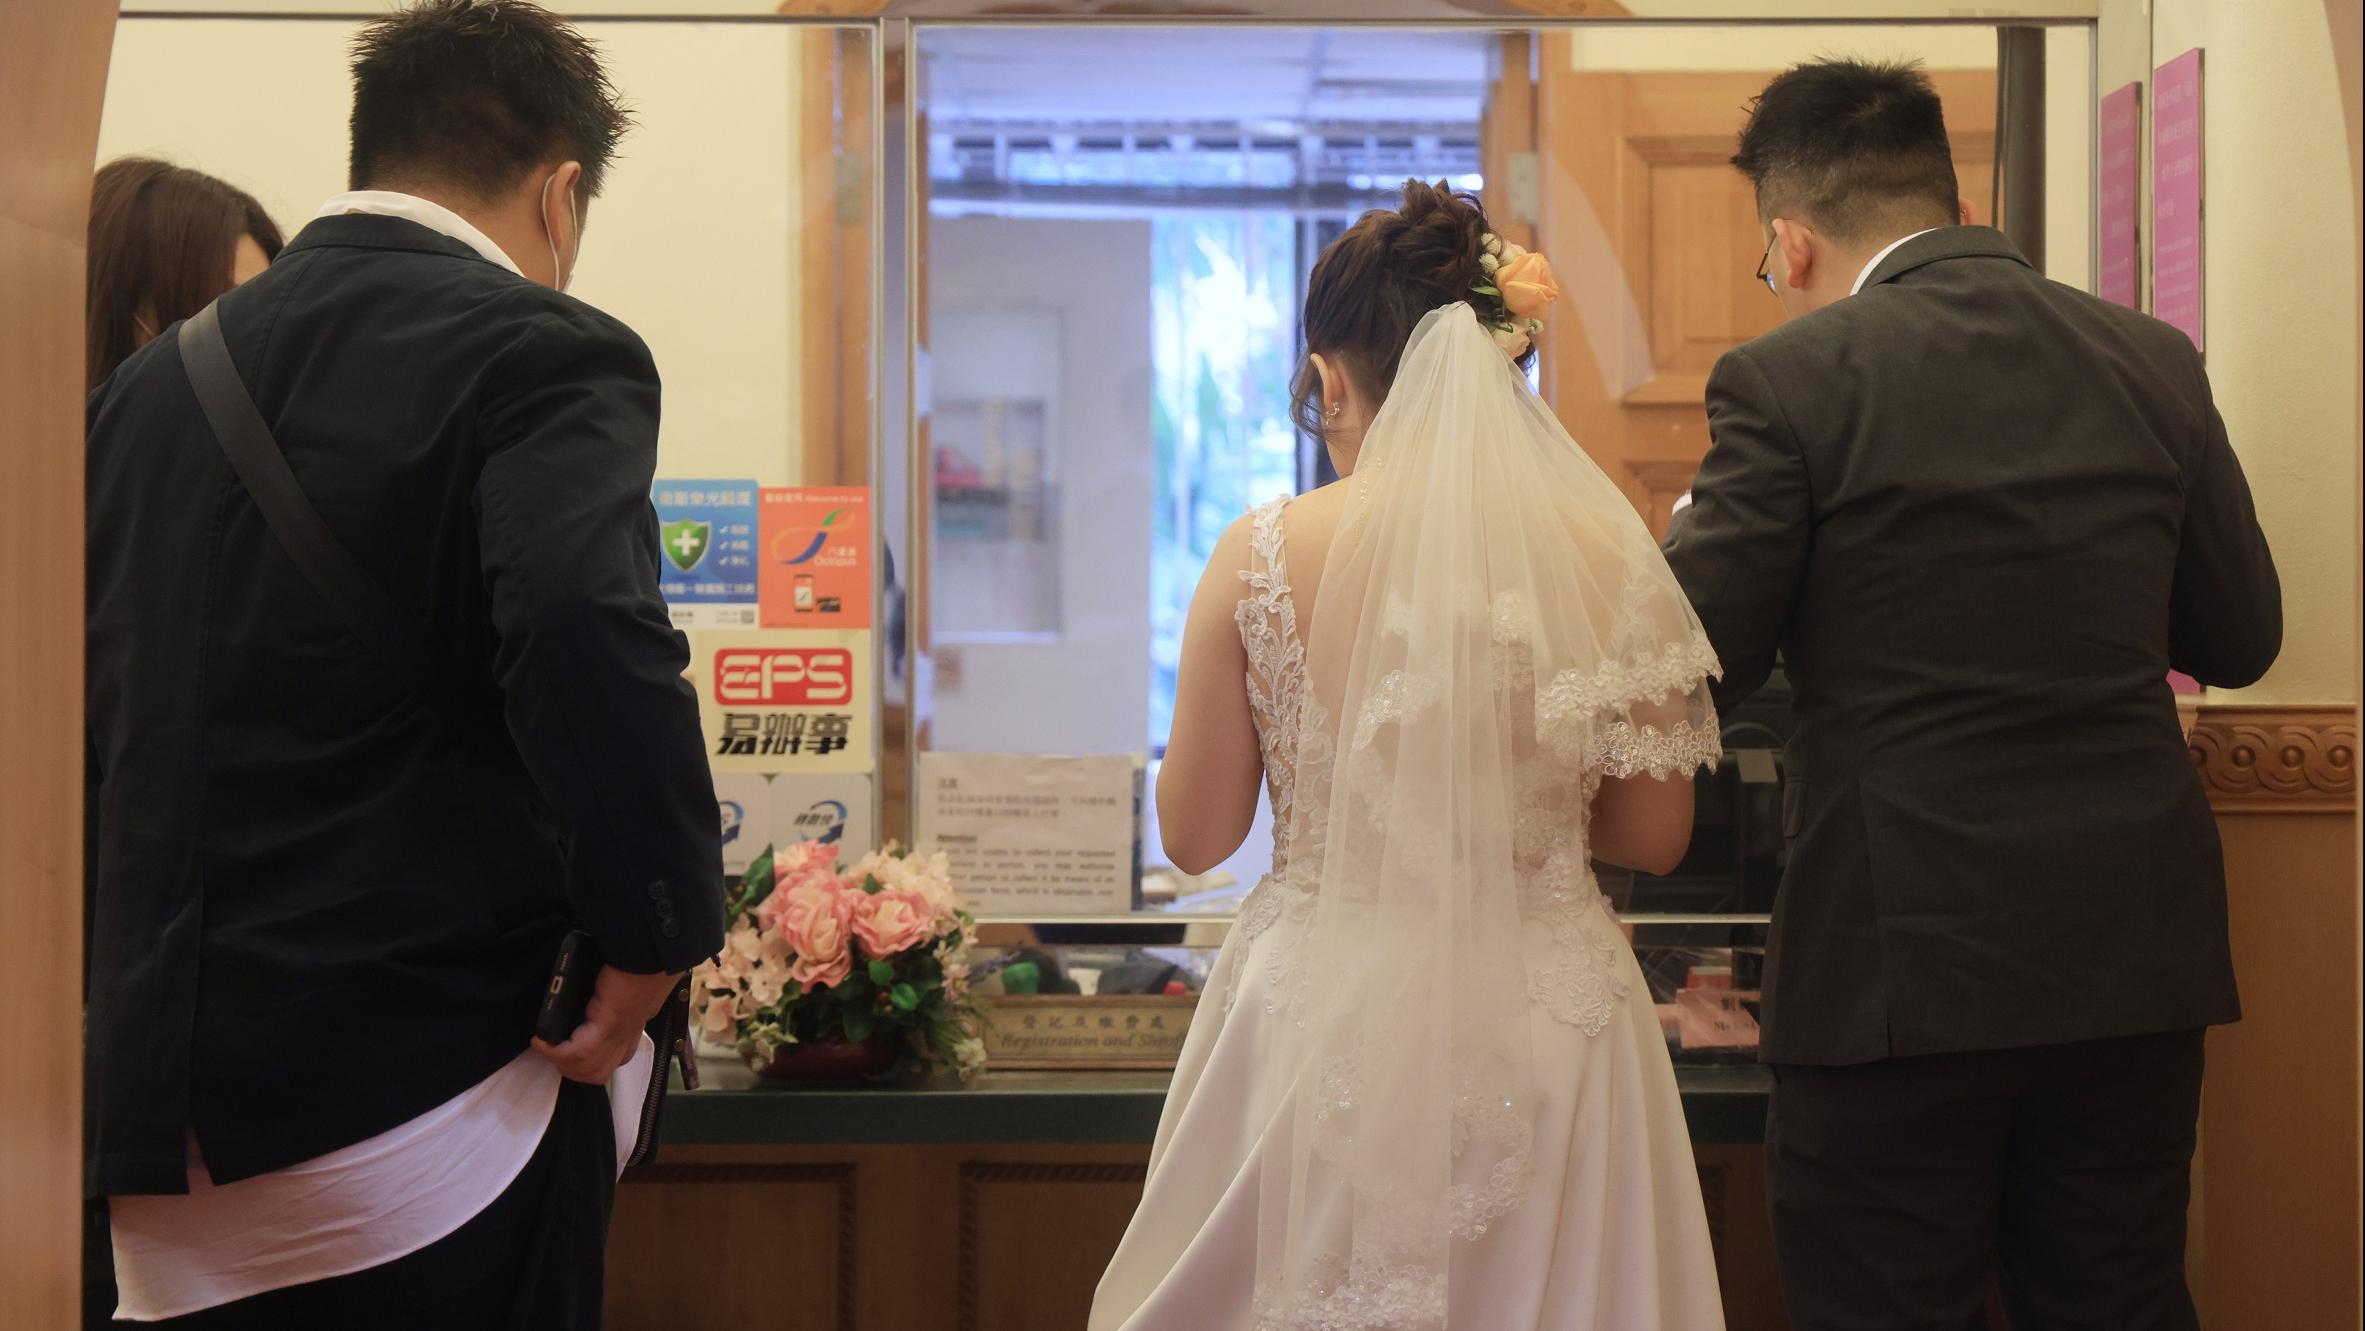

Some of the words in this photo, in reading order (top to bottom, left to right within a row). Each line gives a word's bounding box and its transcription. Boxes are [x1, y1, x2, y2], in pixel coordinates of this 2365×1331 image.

[719, 654, 847, 700] EPS
[716, 712, 853, 756] 易辦事
[997, 1032, 1098, 1054] Registration
[1103, 1032, 1138, 1048] and
